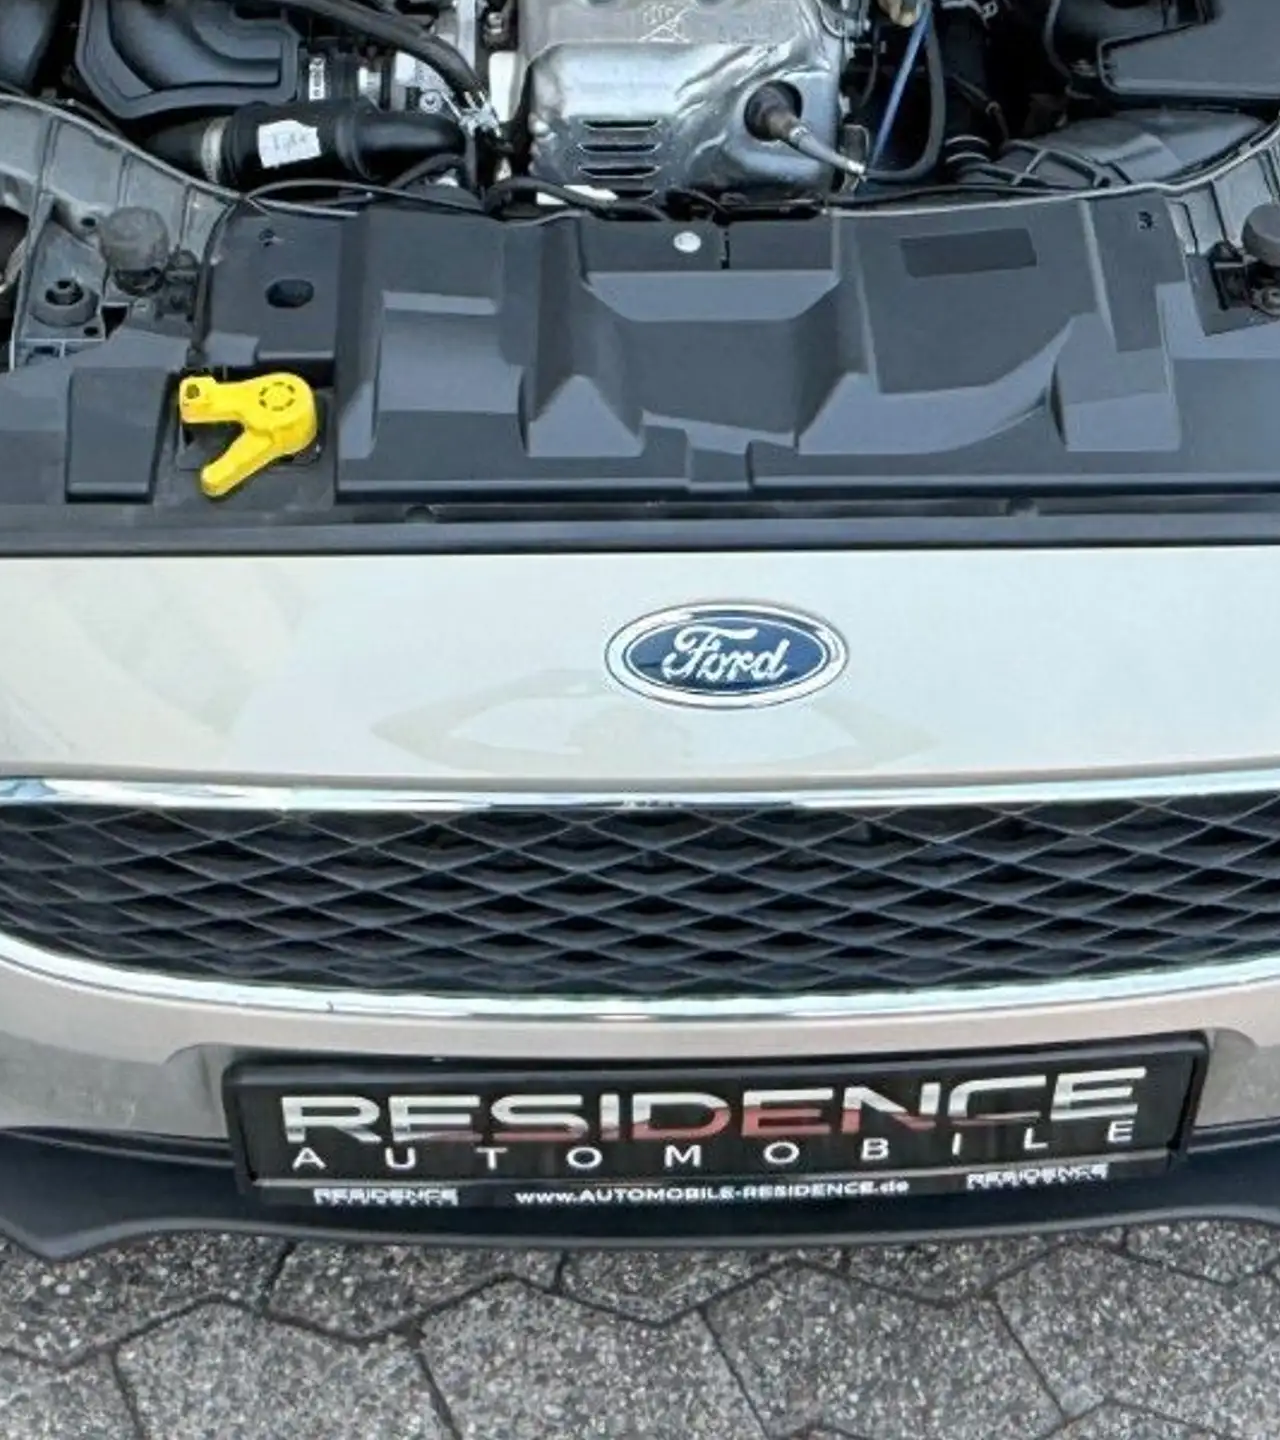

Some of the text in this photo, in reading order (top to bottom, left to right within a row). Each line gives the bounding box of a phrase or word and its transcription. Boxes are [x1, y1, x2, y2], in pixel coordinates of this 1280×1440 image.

[662, 625, 790, 681] Ford
[280, 1067, 1148, 1143] RESIDENCE
[292, 1120, 1135, 1170] AUTOMOBILE
